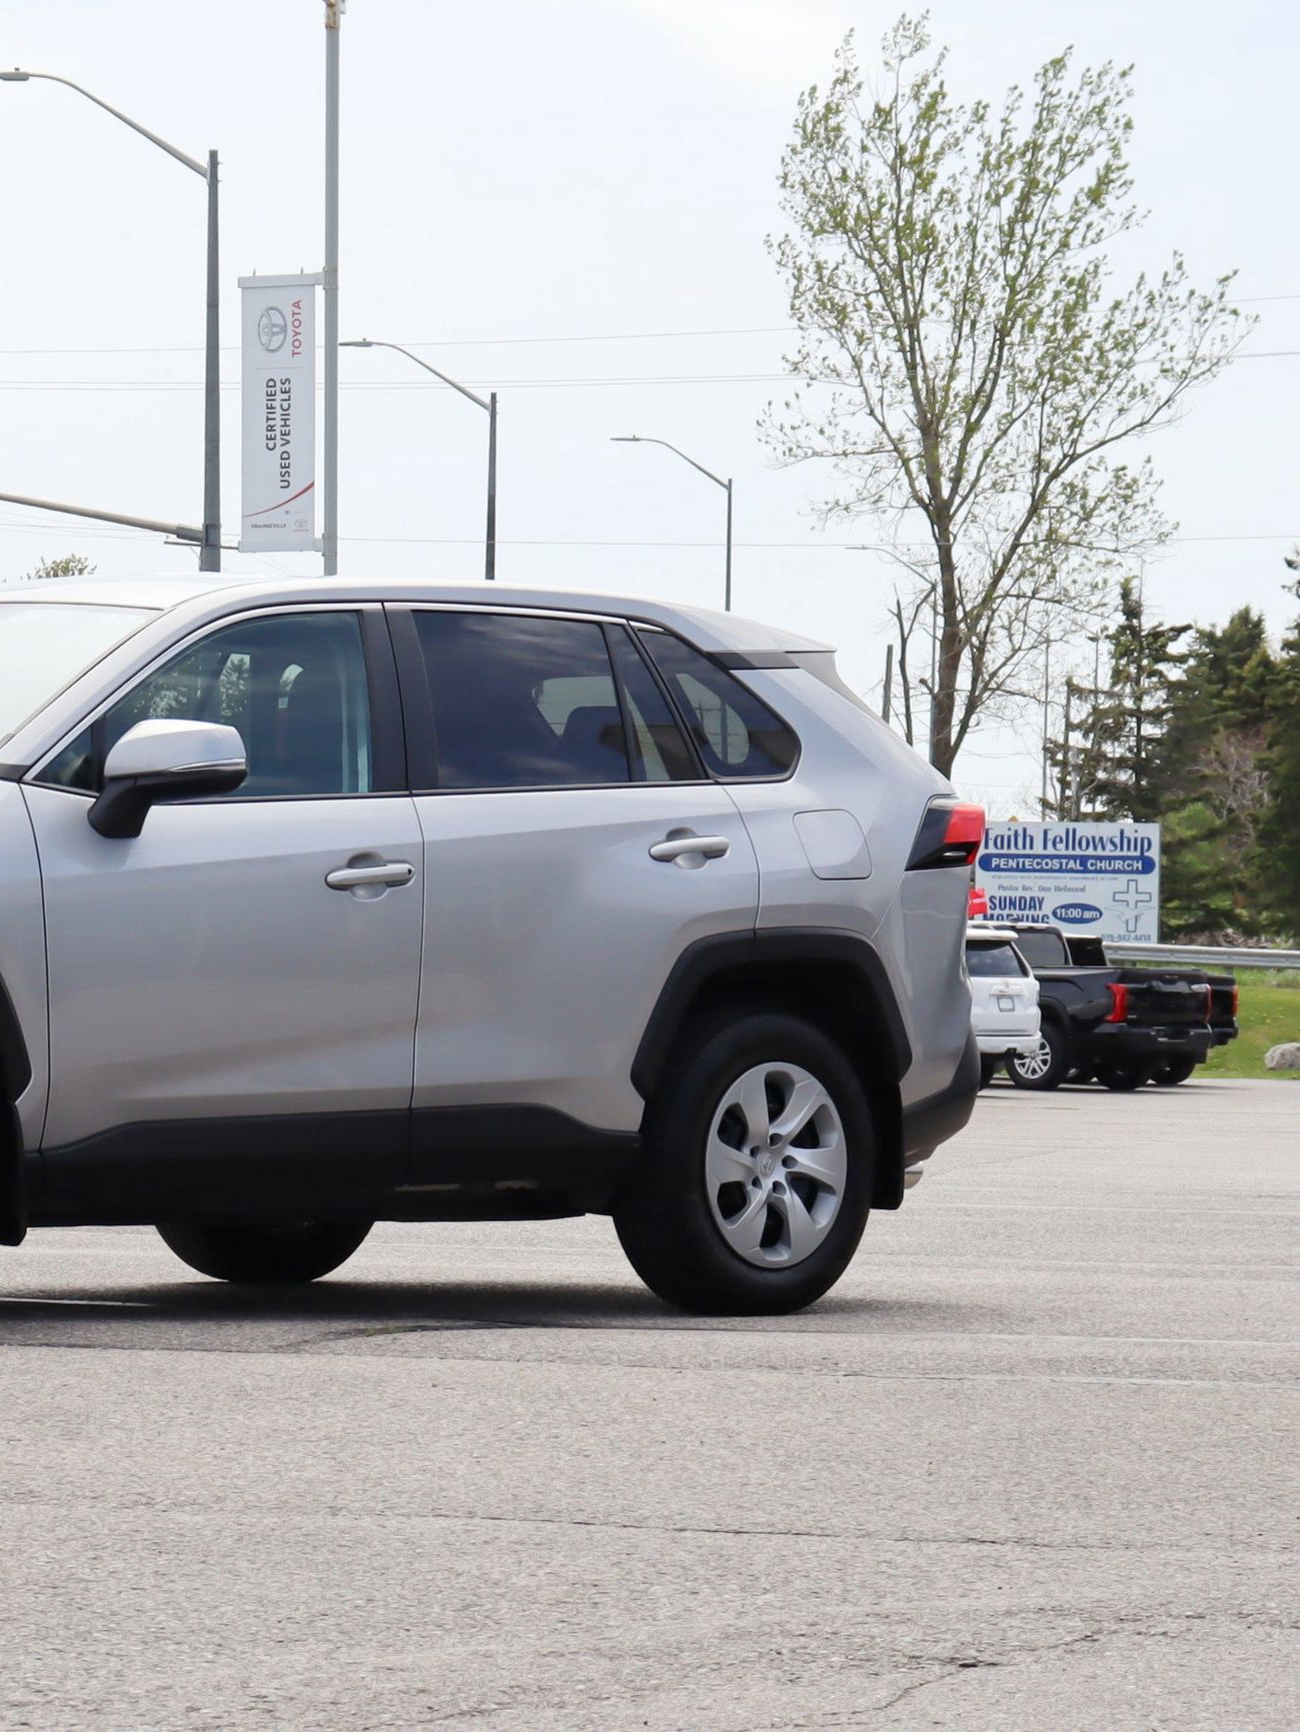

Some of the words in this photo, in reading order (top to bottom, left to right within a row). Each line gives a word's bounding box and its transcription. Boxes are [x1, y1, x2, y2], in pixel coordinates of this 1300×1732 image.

[292, 299, 302, 358] TOYOTA
[266, 378, 277, 451] CERTIFIED
[280, 377, 291, 447] VEHICLES
[280, 450, 291, 489] USED
[984, 827, 1034, 851] Faith
[1042, 827, 1153, 857] Fellowship
[991, 858, 1083, 870] PENTECOSTAL
[1087, 859, 1143, 871] CHURCH
[989, 895, 1045, 911] SUNDAY
[1055, 908, 1082, 919] 11:00
[1083, 909, 1100, 919] am
